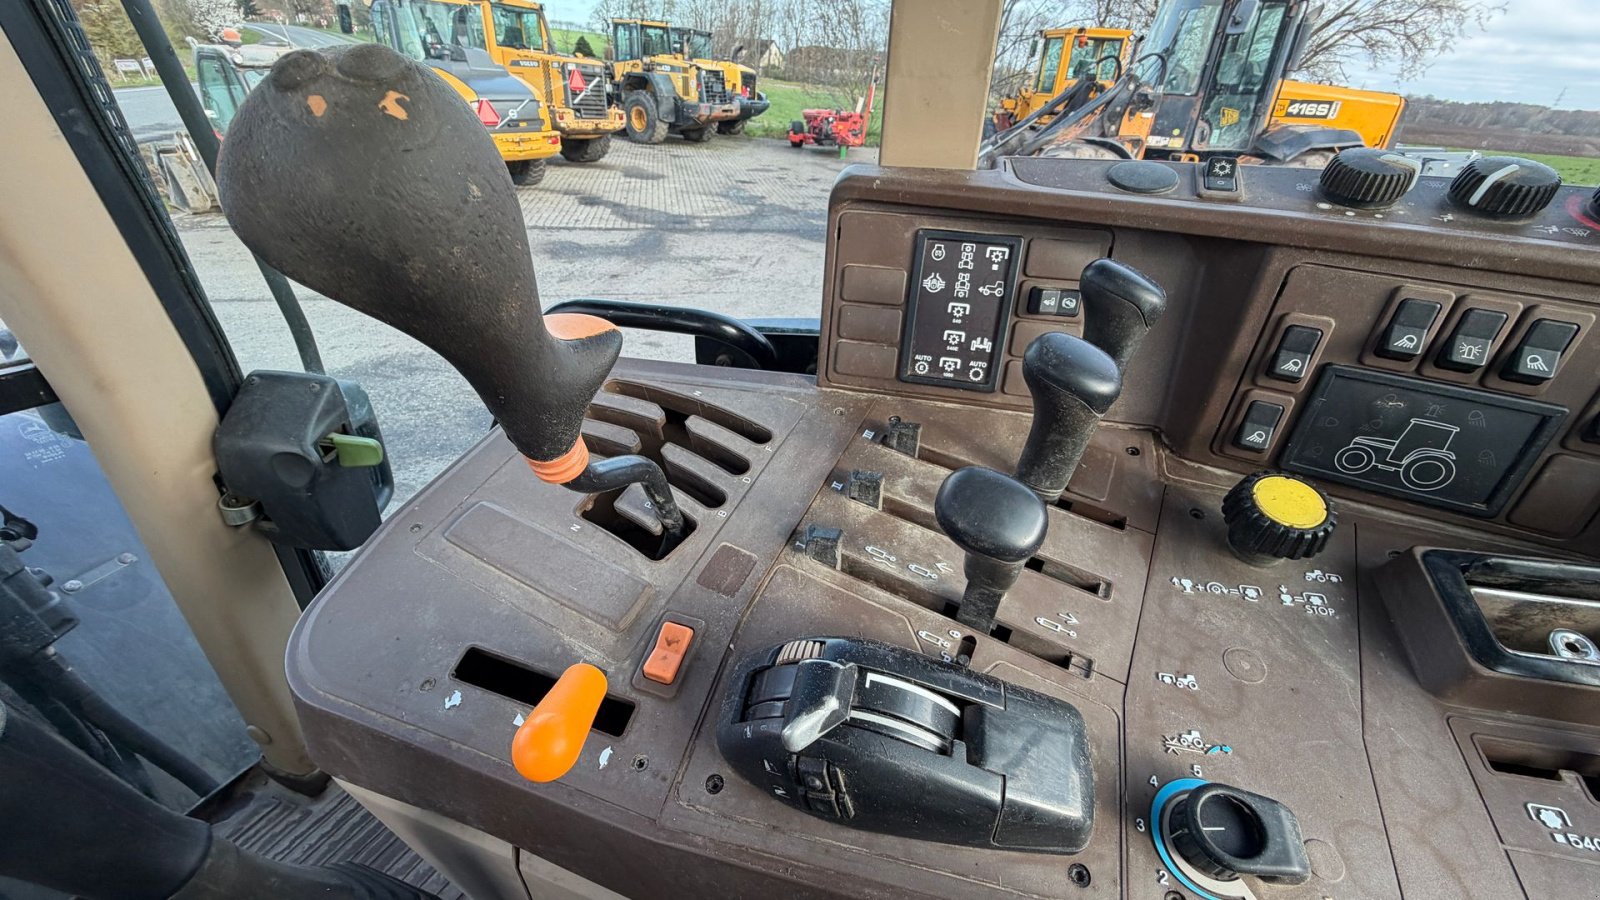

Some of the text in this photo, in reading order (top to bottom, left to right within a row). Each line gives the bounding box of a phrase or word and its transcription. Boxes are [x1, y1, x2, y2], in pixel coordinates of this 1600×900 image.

[1287, 102, 1330, 116] 416S
[764, 444, 773, 453] F
[742, 476, 752, 485] D
[644, 501, 653, 509] P
[717, 509, 727, 518] B
[570, 523, 581, 532] N
[1305, 604, 1335, 617] STOP
[1192, 765, 1203, 777] 5
[1149, 775, 1159, 787] 4
[1135, 818, 1146, 832] 3
[1158, 870, 1169, 886] 2
